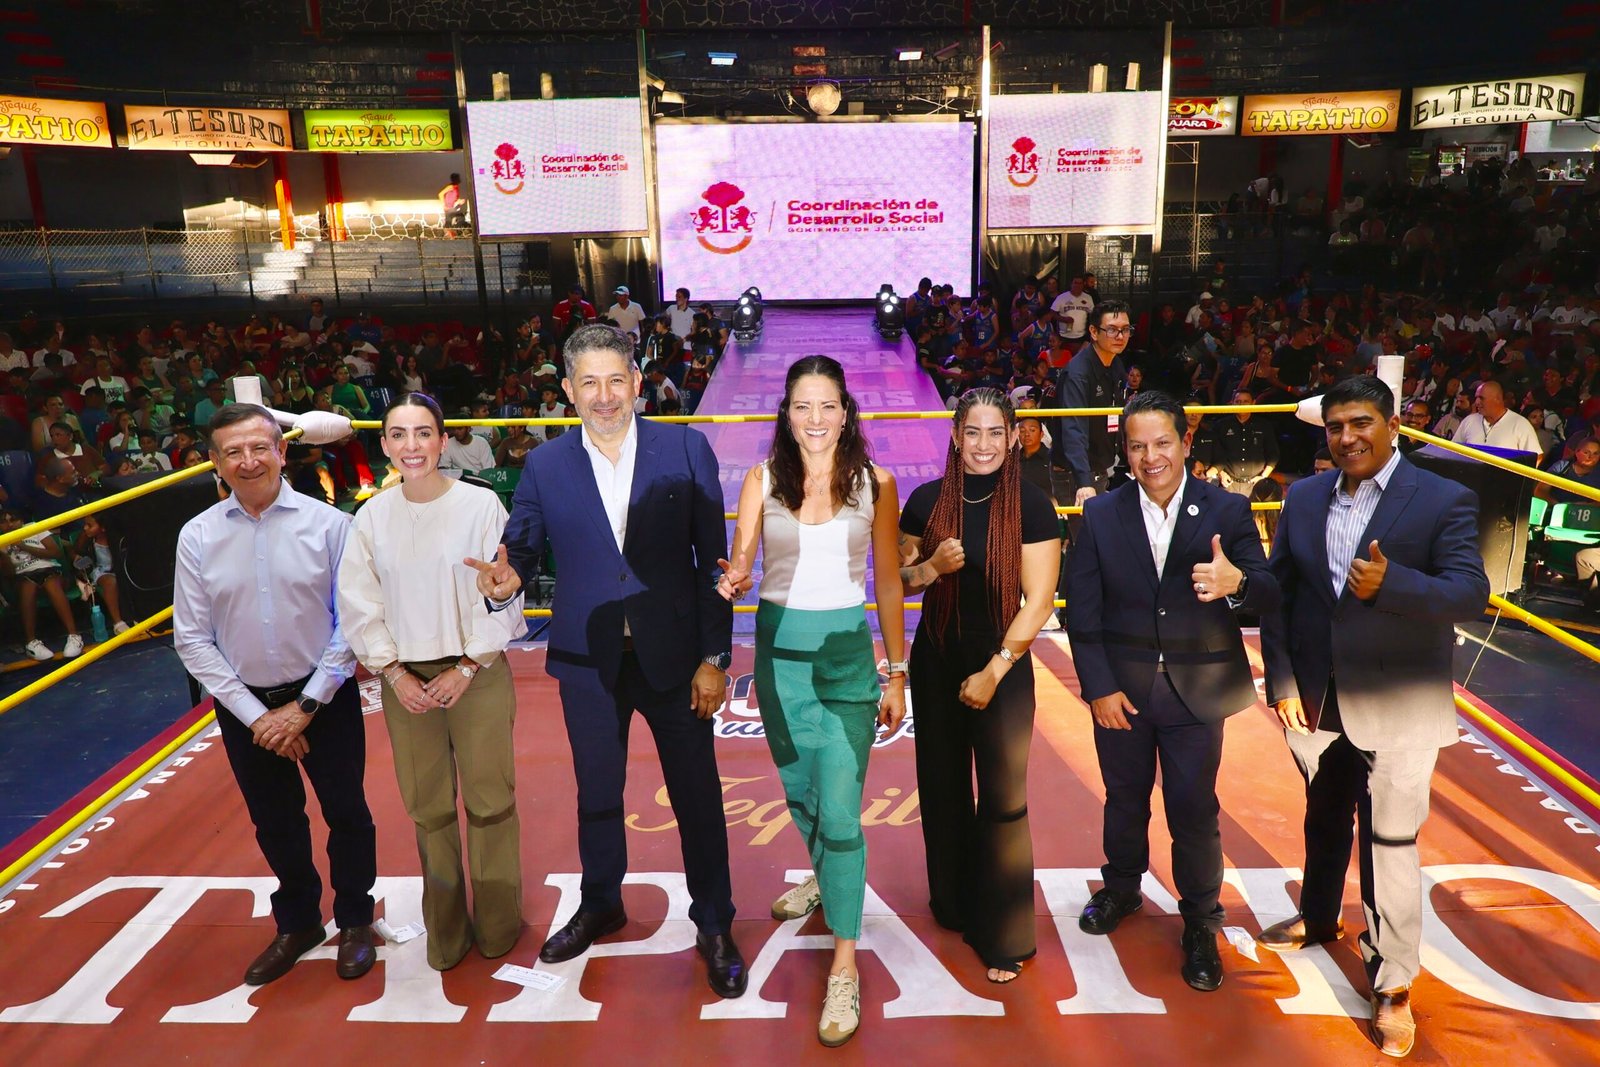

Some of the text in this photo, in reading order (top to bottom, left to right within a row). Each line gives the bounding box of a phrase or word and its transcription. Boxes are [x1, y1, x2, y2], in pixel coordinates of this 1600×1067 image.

[0, 100, 42, 114] Tequila
[1302, 97, 1340, 109] Tequila
[1413, 82, 1575, 127] EL TESORO
[1249, 107, 1389, 132] TAPATIO
[1450, 113, 1537, 125] TEQUILA
[130, 109, 285, 148] EL TESORO
[311, 125, 445, 147] TAPATIO
[787, 199, 939, 212] Coordinación de
[787, 211, 944, 226] Desarrollo Social
[496, 470, 507, 482] 24
[1577, 509, 1591, 522] 18
[124, 725, 222, 802] ARENA
[1458, 725, 1600, 853] DALAJA
